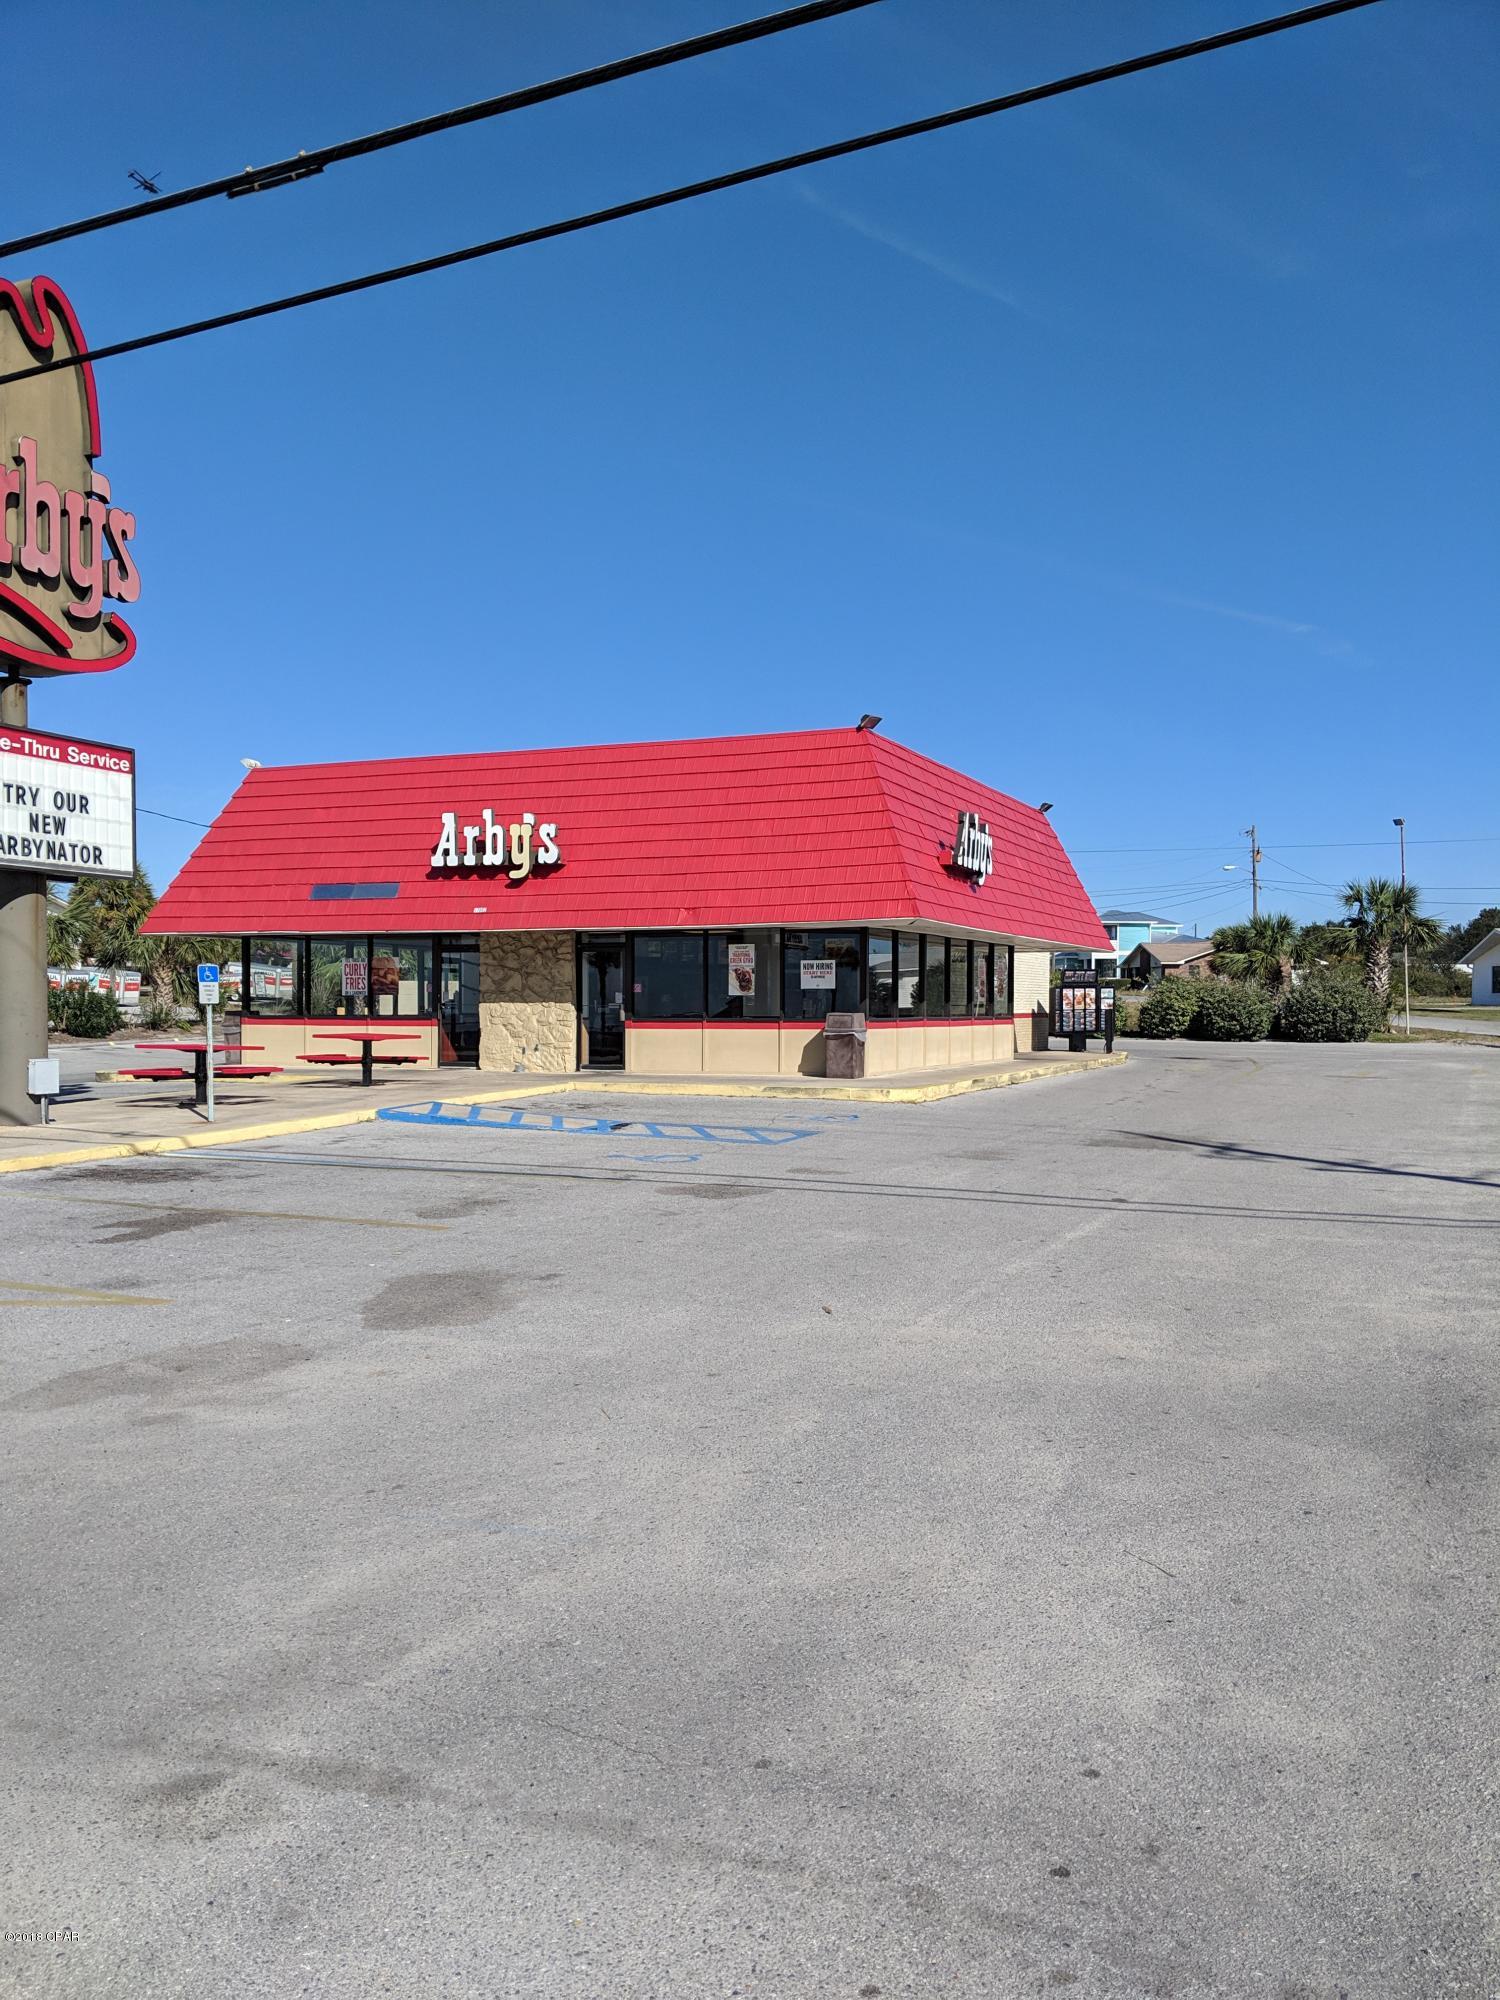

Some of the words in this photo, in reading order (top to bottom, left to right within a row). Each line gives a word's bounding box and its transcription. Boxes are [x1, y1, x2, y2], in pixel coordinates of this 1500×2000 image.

[67, 746, 130, 771] Service
[3, 783, 40, 807] TRY
[53, 791, 89, 814] OUR
[29, 812, 66, 836] NEW
[0, 834, 103, 865] ARBYNATOR
[431, 808, 560, 878] Arby's
[957, 812, 993, 885] Arby's
[344, 963, 368, 977] CURLY
[803, 962, 815, 971] NOW
[815, 962, 834, 971] HIRING
[345, 977, 366, 991] FRIES
